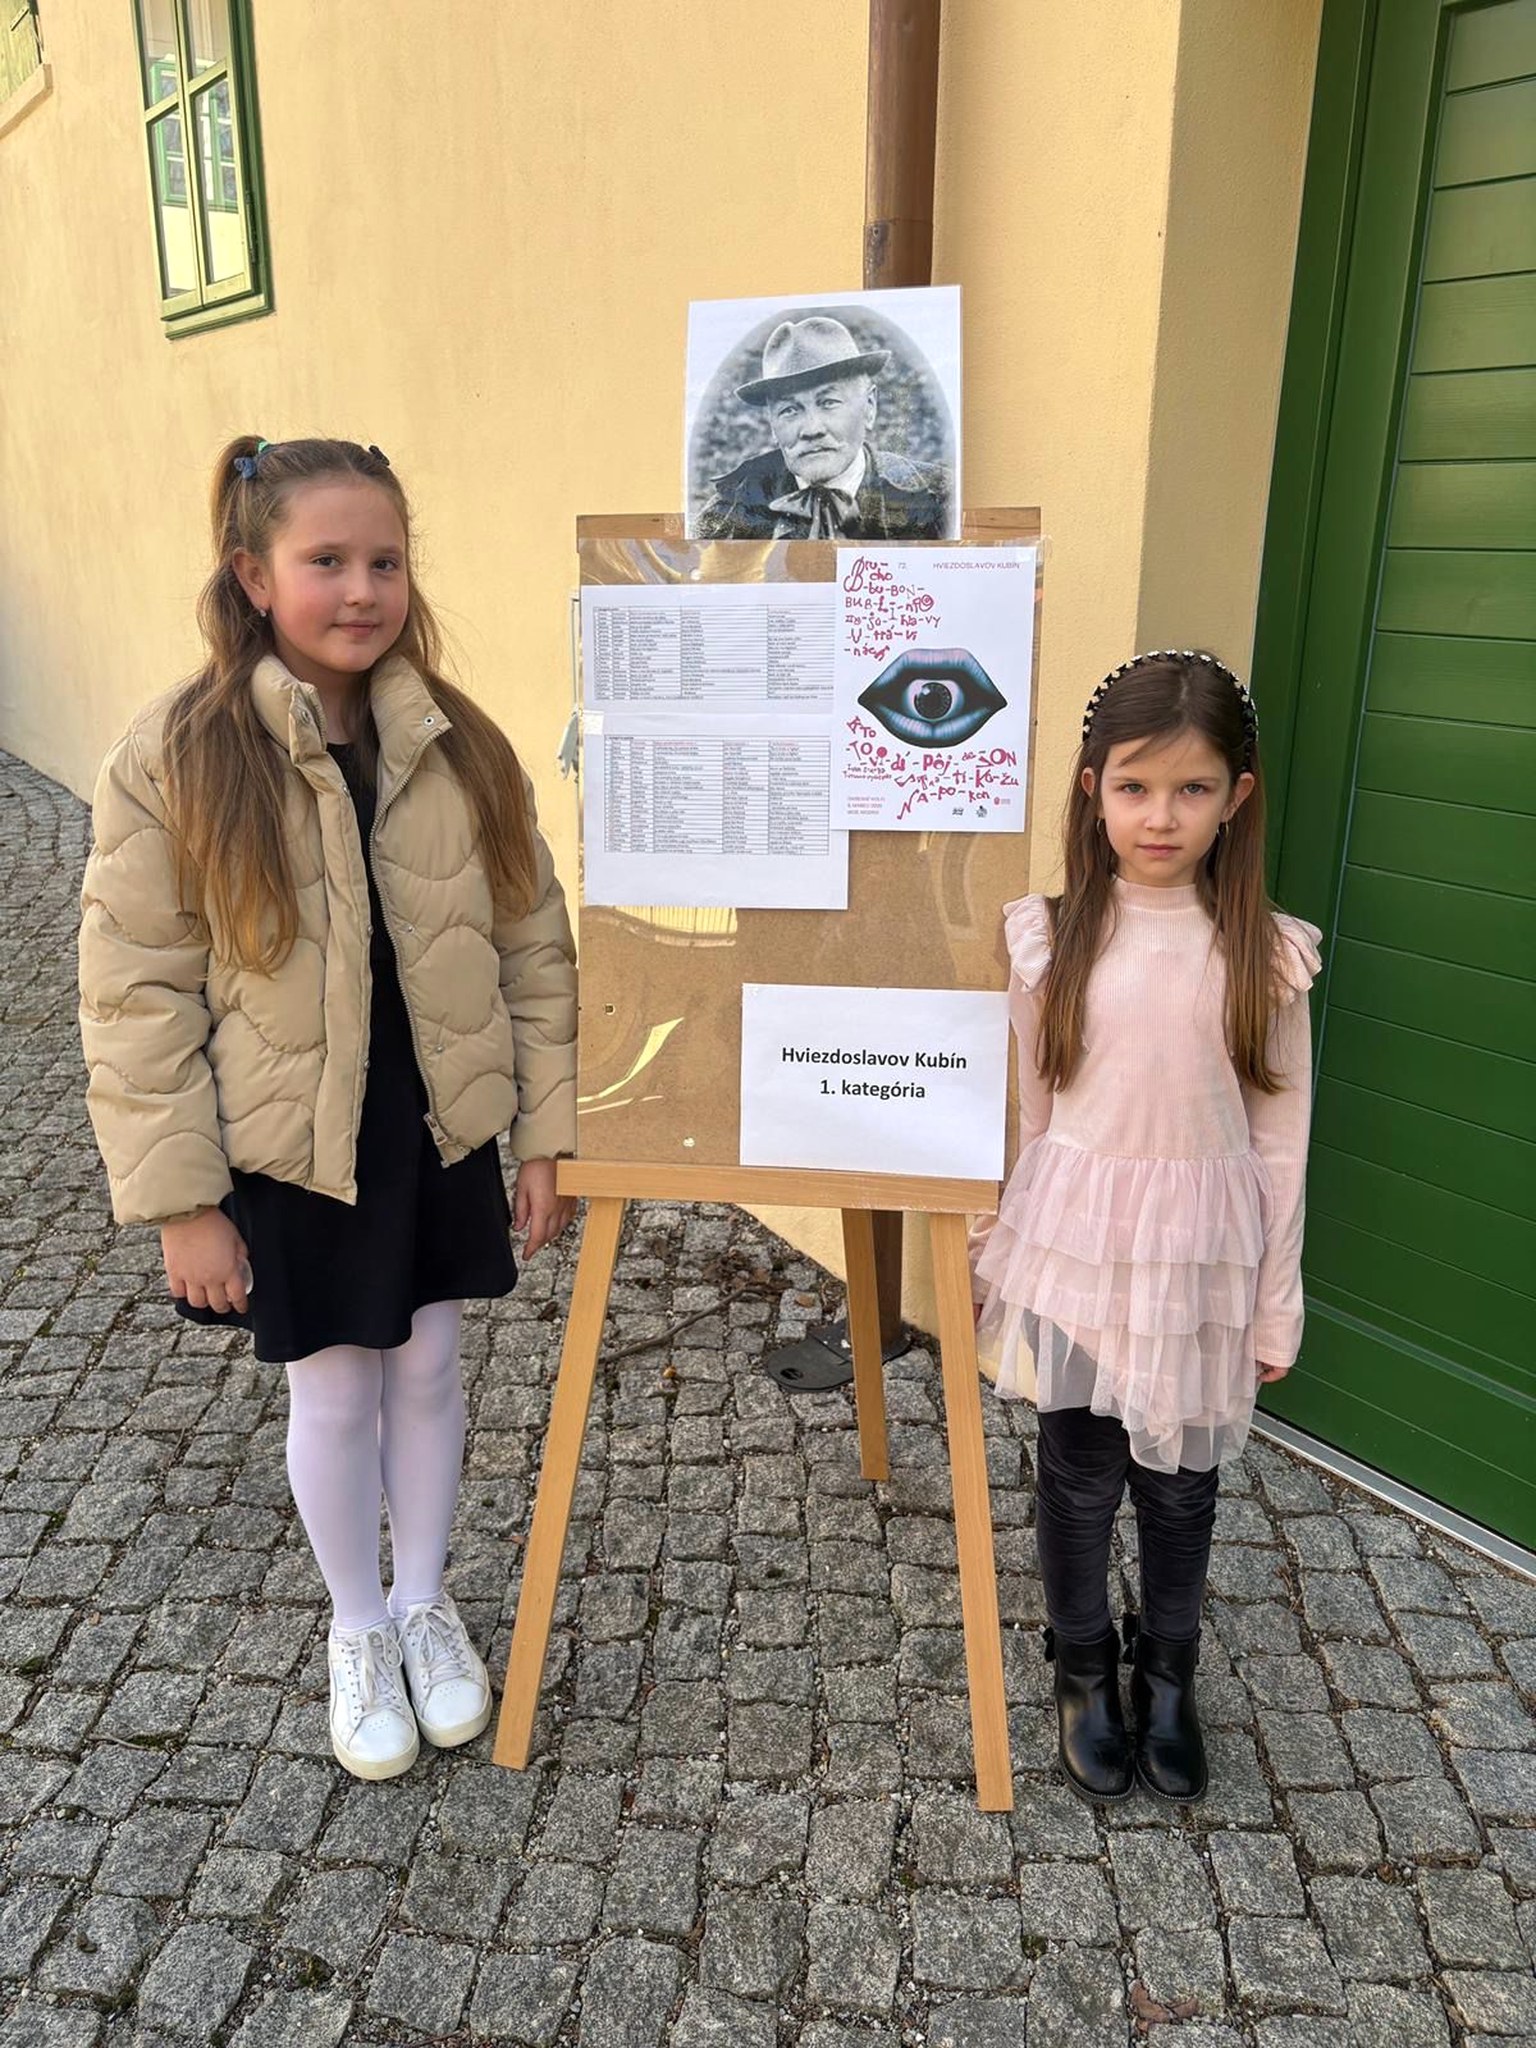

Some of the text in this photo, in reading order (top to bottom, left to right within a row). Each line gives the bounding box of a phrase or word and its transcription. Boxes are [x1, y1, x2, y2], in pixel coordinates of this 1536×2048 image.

[932, 562, 995, 570] HVIEZDOSLAVOV
[781, 1046, 968, 1070] Hviezdoslavov Kubín
[819, 1079, 926, 1101] 1. kategória
